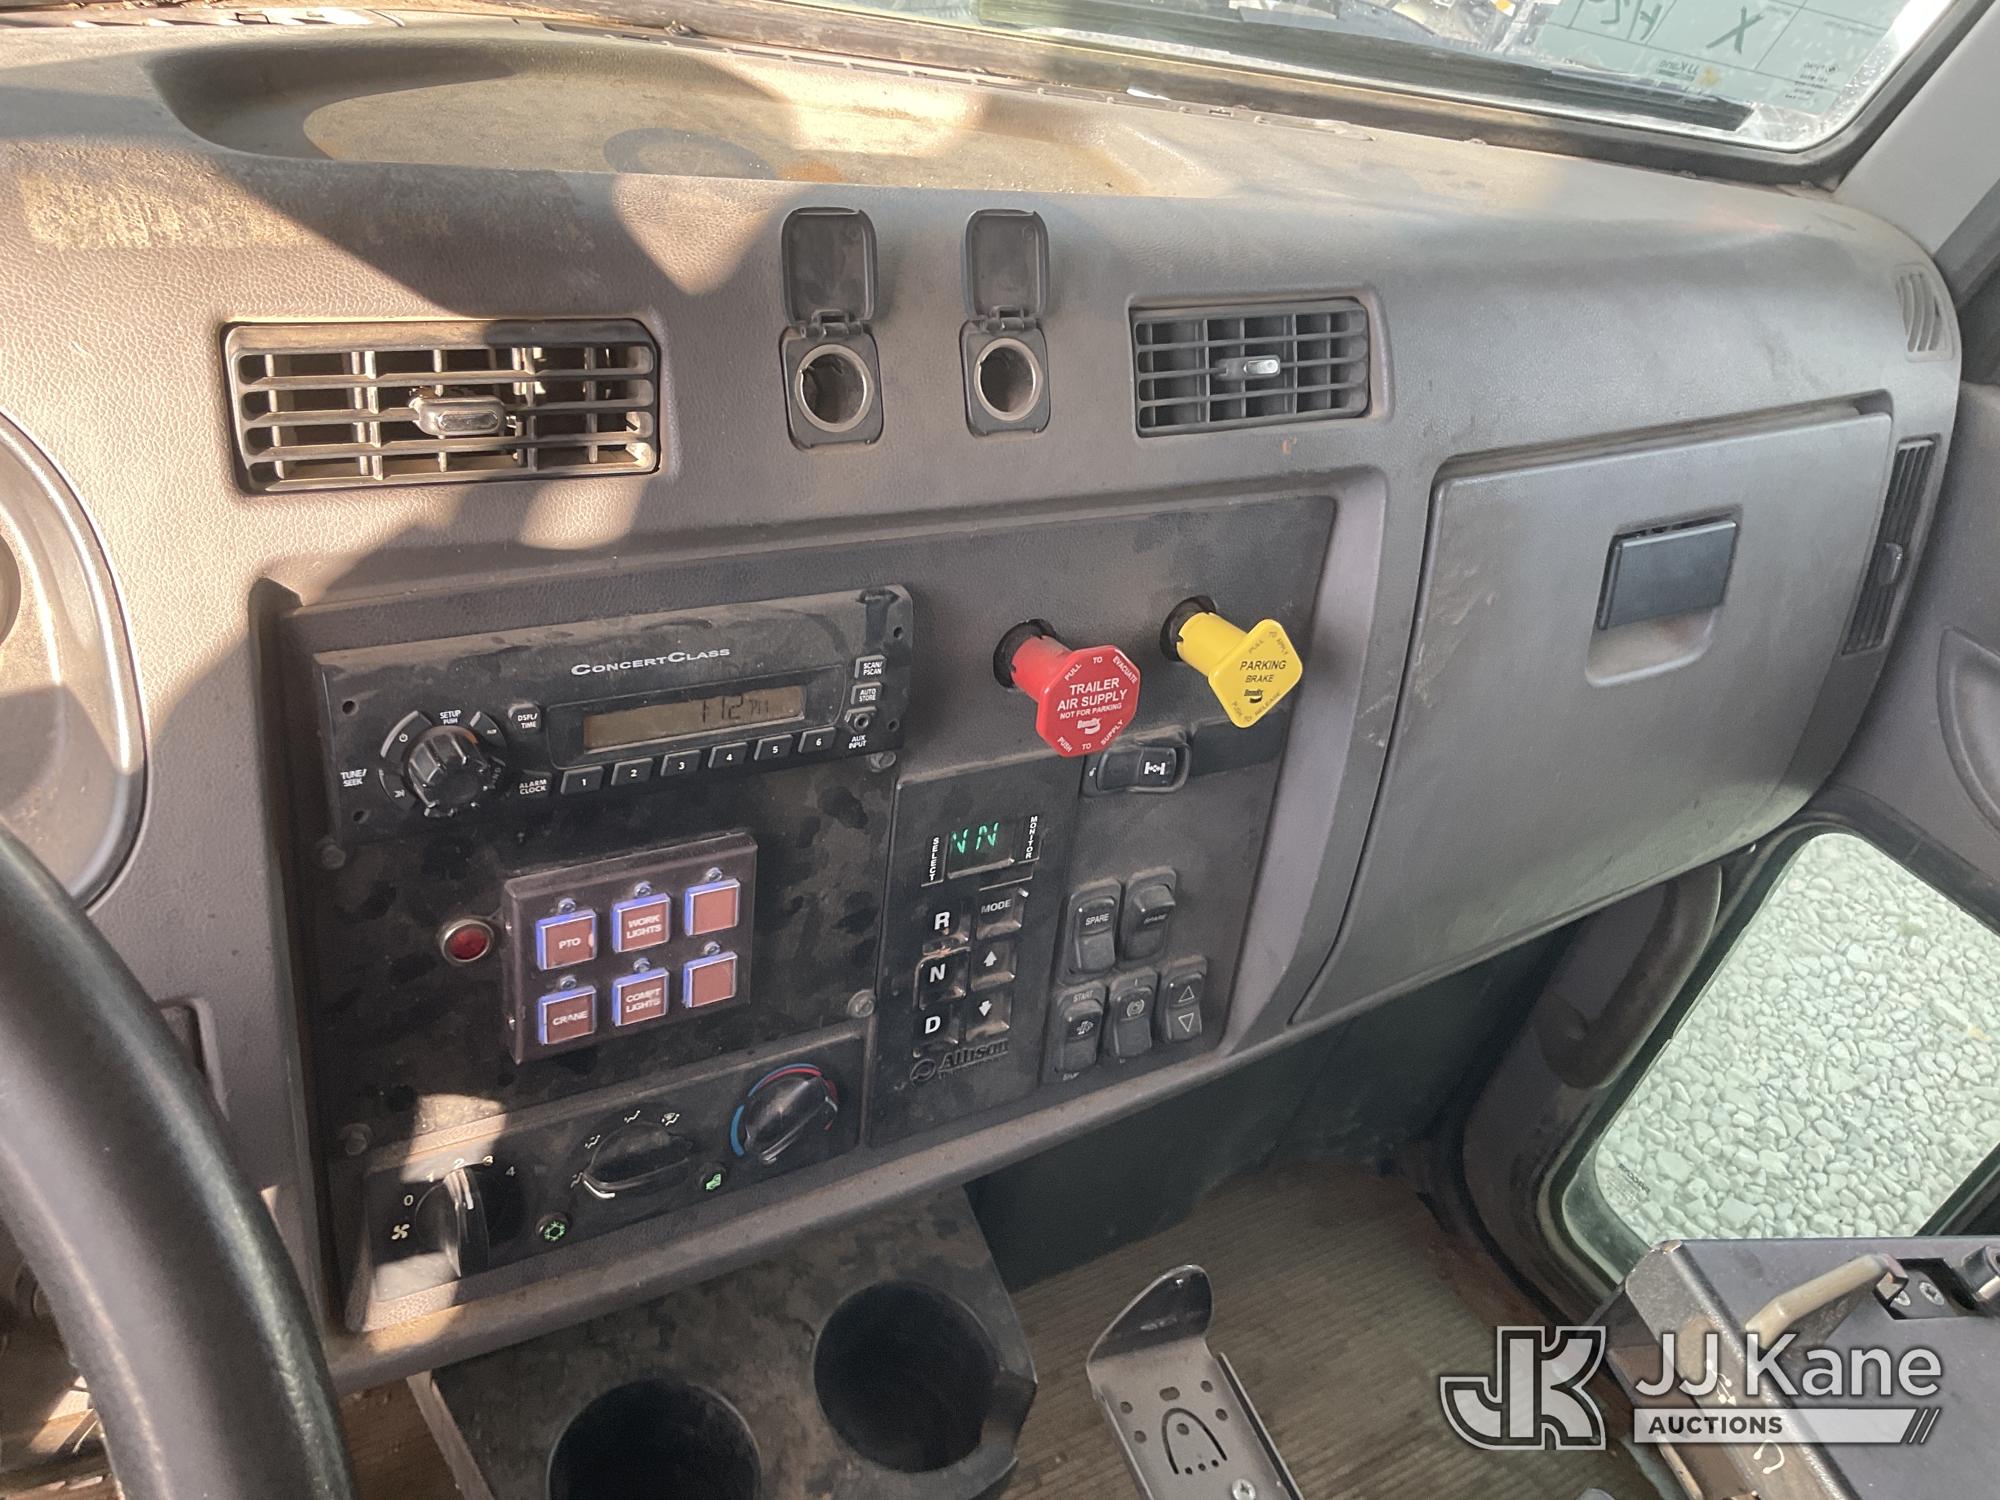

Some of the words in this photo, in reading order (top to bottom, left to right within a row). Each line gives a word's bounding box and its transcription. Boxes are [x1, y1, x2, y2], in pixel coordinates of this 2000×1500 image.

[1064, 663, 1083, 681] PULL
[1093, 656, 1103, 665] TO
[1112, 655, 1138, 685] EVACUATE
[1240, 659, 1287, 671] PARKING
[1245, 674, 1275, 684] BRAKE
[860, 688, 877, 696] AUTO
[1069, 677, 1120, 696] TRAILER
[859, 694, 877, 703] STORE
[1057, 698, 1079, 712] AIR
[1081, 688, 1128, 707] SUPPLY
[440, 709, 462, 720] SETUP
[1060, 711, 1076, 720] NOT
[1076, 707, 1091, 717] FOR
[1092, 702, 1122, 715] PARKING
[521, 721, 538, 730] TIME
[815, 737, 822, 747] 6
[852, 734, 867, 743] AUX
[1057, 736, 1073, 753] PUSH
[1082, 743, 1092, 751] TO
[1100, 719, 1124, 746] SUPPLY
[772, 745, 779, 754] 5
[848, 740, 867, 750] INPUT
[725, 753, 734, 761] 4
[678, 761, 686, 771] 3
[630, 769, 638, 778] 2
[343, 777, 364, 787] SEEK
[519, 779, 548, 790] ALARM
[581, 778, 588, 787] 1
[519, 785, 548, 796] CLOCK
[1025, 815, 1039, 860] MONITOR
[929, 836, 941, 882] SELECT
[981, 899, 1013, 914] MODE
[627, 914, 661, 928] WORK
[934, 911, 951, 931] R
[1085, 912, 1110, 926] SPARE
[626, 924, 663, 939] LIGHTS
[558, 937, 582, 949] PTO
[929, 963, 946, 983] N
[1072, 989, 1094, 1003] START
[625, 998, 661, 1013] LIGHTS
[552, 1010, 590, 1026] CRANE
[924, 1015, 942, 1034] D
[426, 1170, 434, 1182] 1
[482, 1155, 494, 1167] 3
[505, 1166, 516, 1176] 4
